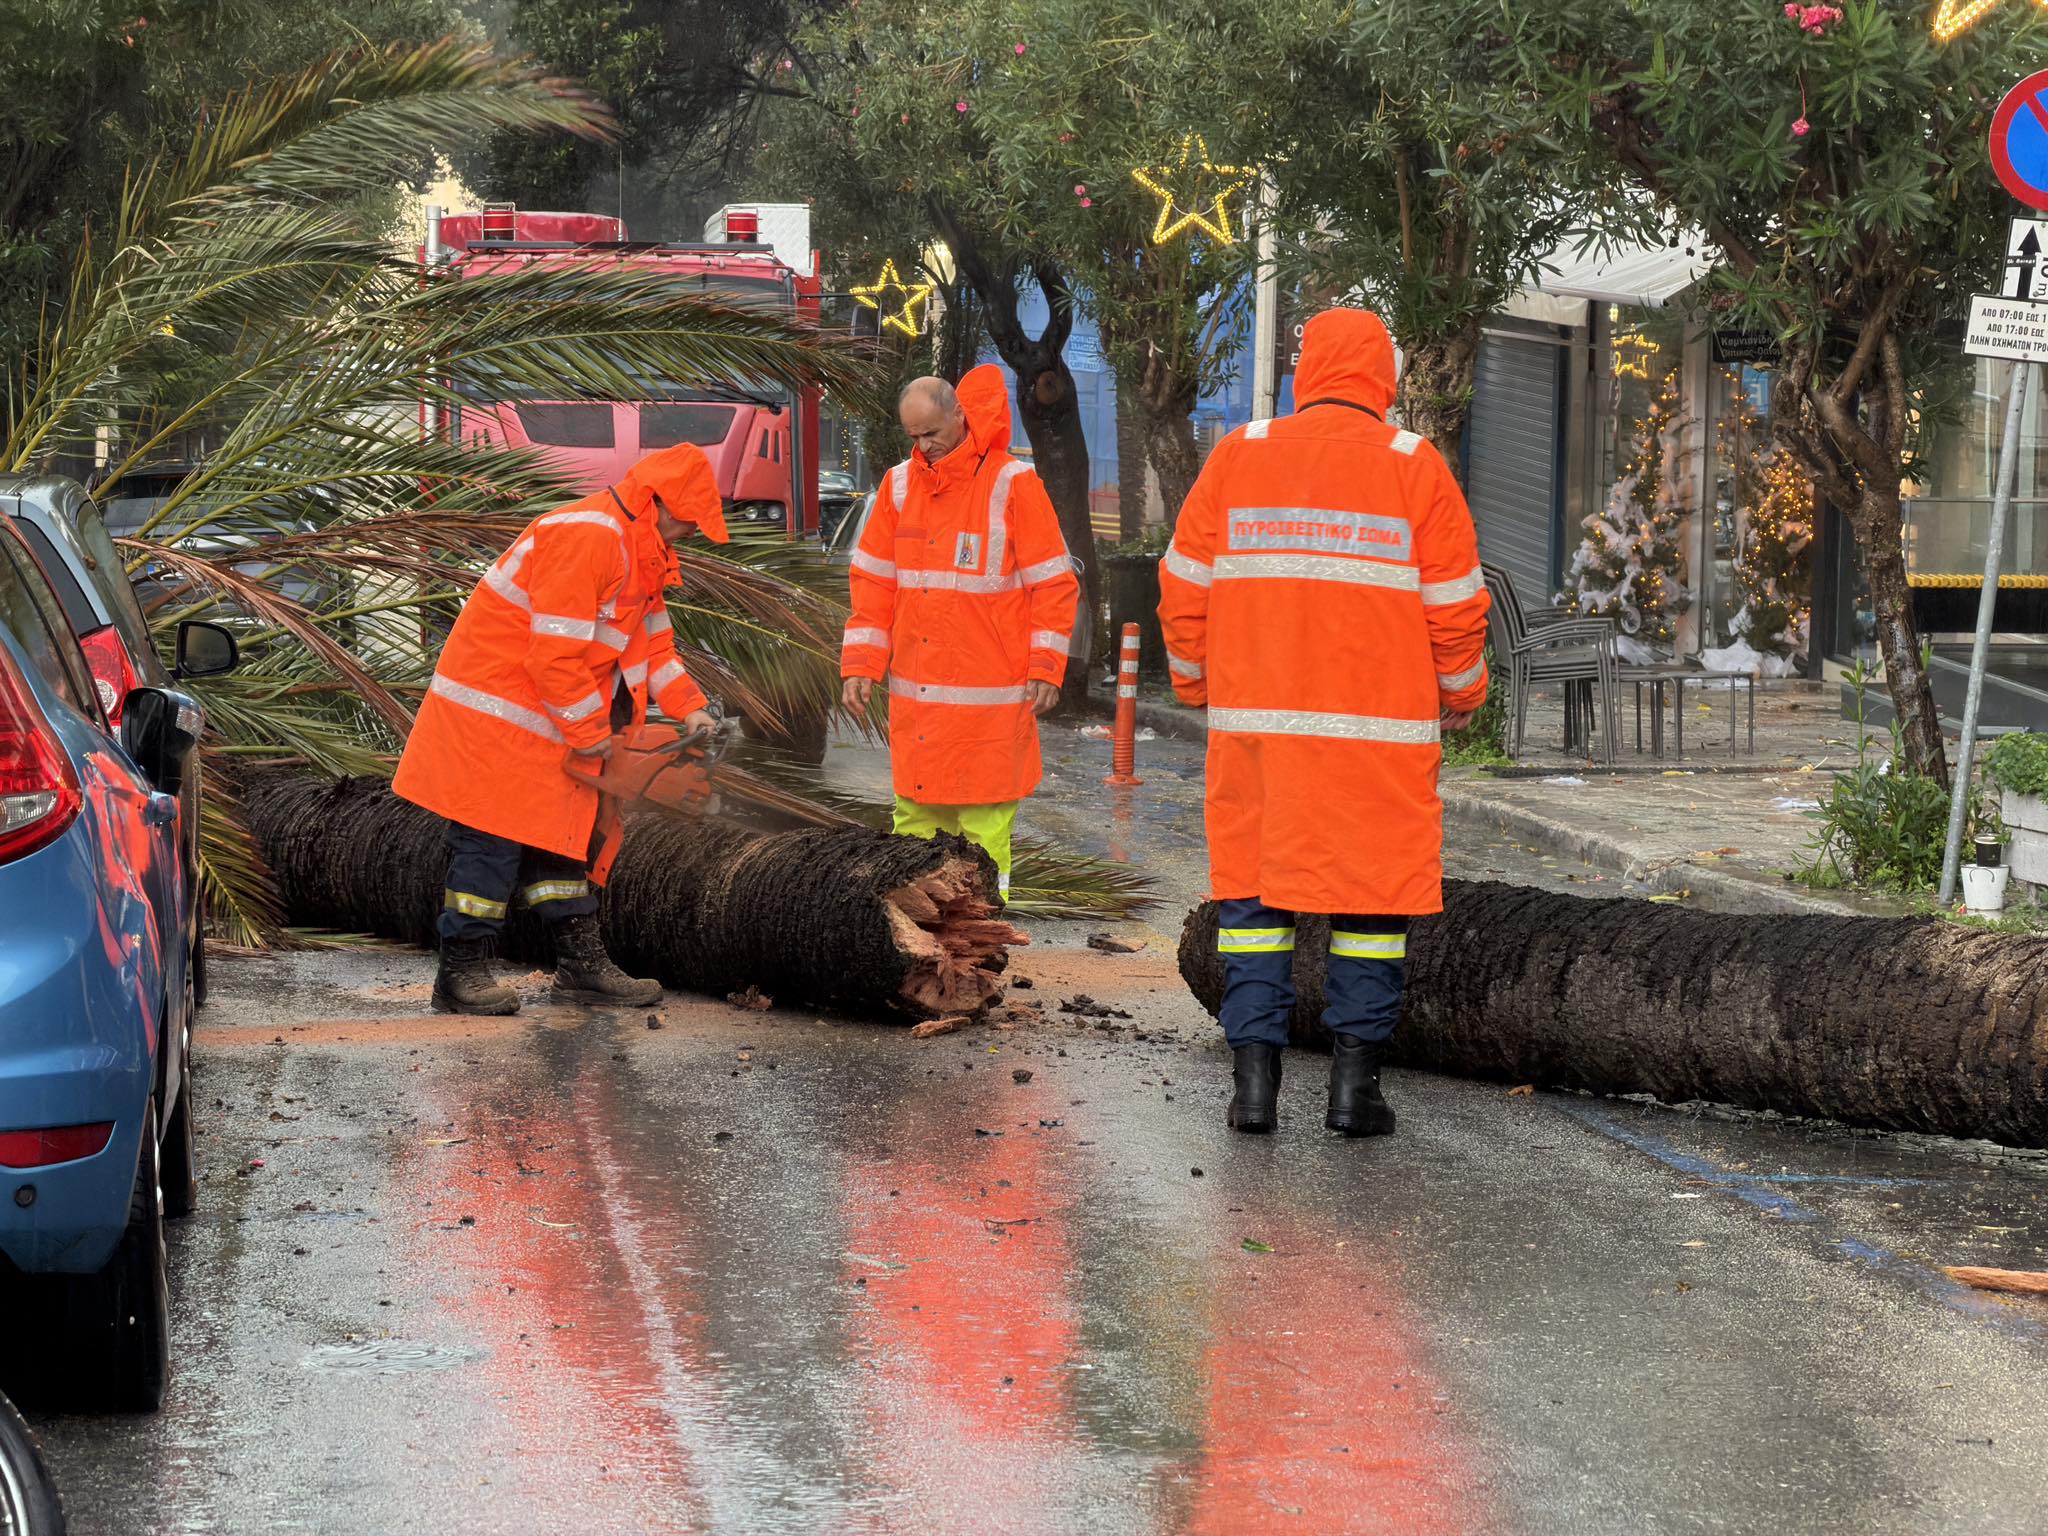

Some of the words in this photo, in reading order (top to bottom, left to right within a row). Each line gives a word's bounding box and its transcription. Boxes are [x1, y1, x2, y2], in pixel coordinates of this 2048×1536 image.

[1981, 308, 1997, 318] ΑΠΟ
[1999, 309, 2024, 320] 07:00
[2026, 313, 2040, 323] ΕΩΣ
[1986, 323, 2002, 333] ΑΠΟ
[2006, 324, 2029, 335] 17:00
[2031, 328, 2045, 338] ΕΩΣ
[1970, 334, 1991, 346] ΠΛΗΝ
[1992, 337, 2032, 351] ΟΧΗΜΑΤΩΝ
[1234, 521, 1353, 540] ΠΥΡΟΣΒΕΣΤΙΚΟ
[1357, 527, 1402, 546] ΣΩΜΑ
